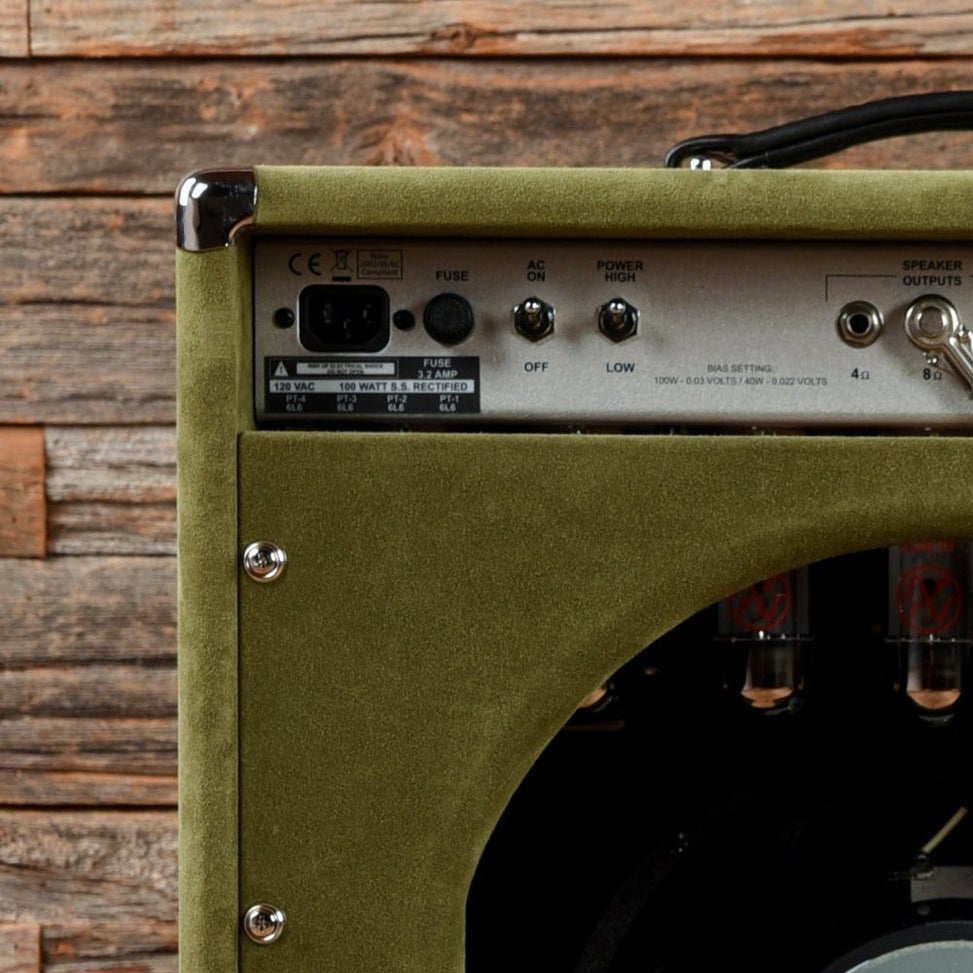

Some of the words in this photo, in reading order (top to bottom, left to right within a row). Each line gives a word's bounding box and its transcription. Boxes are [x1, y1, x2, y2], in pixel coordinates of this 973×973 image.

[527, 260, 546, 271] AC
[597, 260, 644, 272] POWER
[902, 260, 963, 272] SPEAKER
[436, 270, 469, 282] FUSE
[527, 272, 546, 283] ON
[604, 271, 636, 283] HIGH
[902, 275, 963, 287] OUTPUTS
[423, 359, 451, 368] FUSE
[524, 362, 549, 373] OFF
[606, 363, 635, 374] LOW
[707, 364, 731, 373] BIAS
[417, 370, 432, 380] 3.2
[434, 370, 458, 380] AMP
[654, 376, 678, 386] 100W
[707, 376, 737, 385] VOLTS
[745, 376, 764, 385] 40W
[798, 377, 828, 386] VOLTS
[274, 382, 291, 391] 120
[293, 382, 315, 391] VAC
[339, 382, 356, 391] 100
[358, 382, 388, 391] WATT
[391, 382, 411, 391] S.S.
[413, 382, 468, 391] RECTIFIED
[387, 395, 407, 404] PT-2
[440, 395, 459, 404] PT-1
[387, 404, 405, 412] 6L6
[439, 404, 456, 412] 6L6
